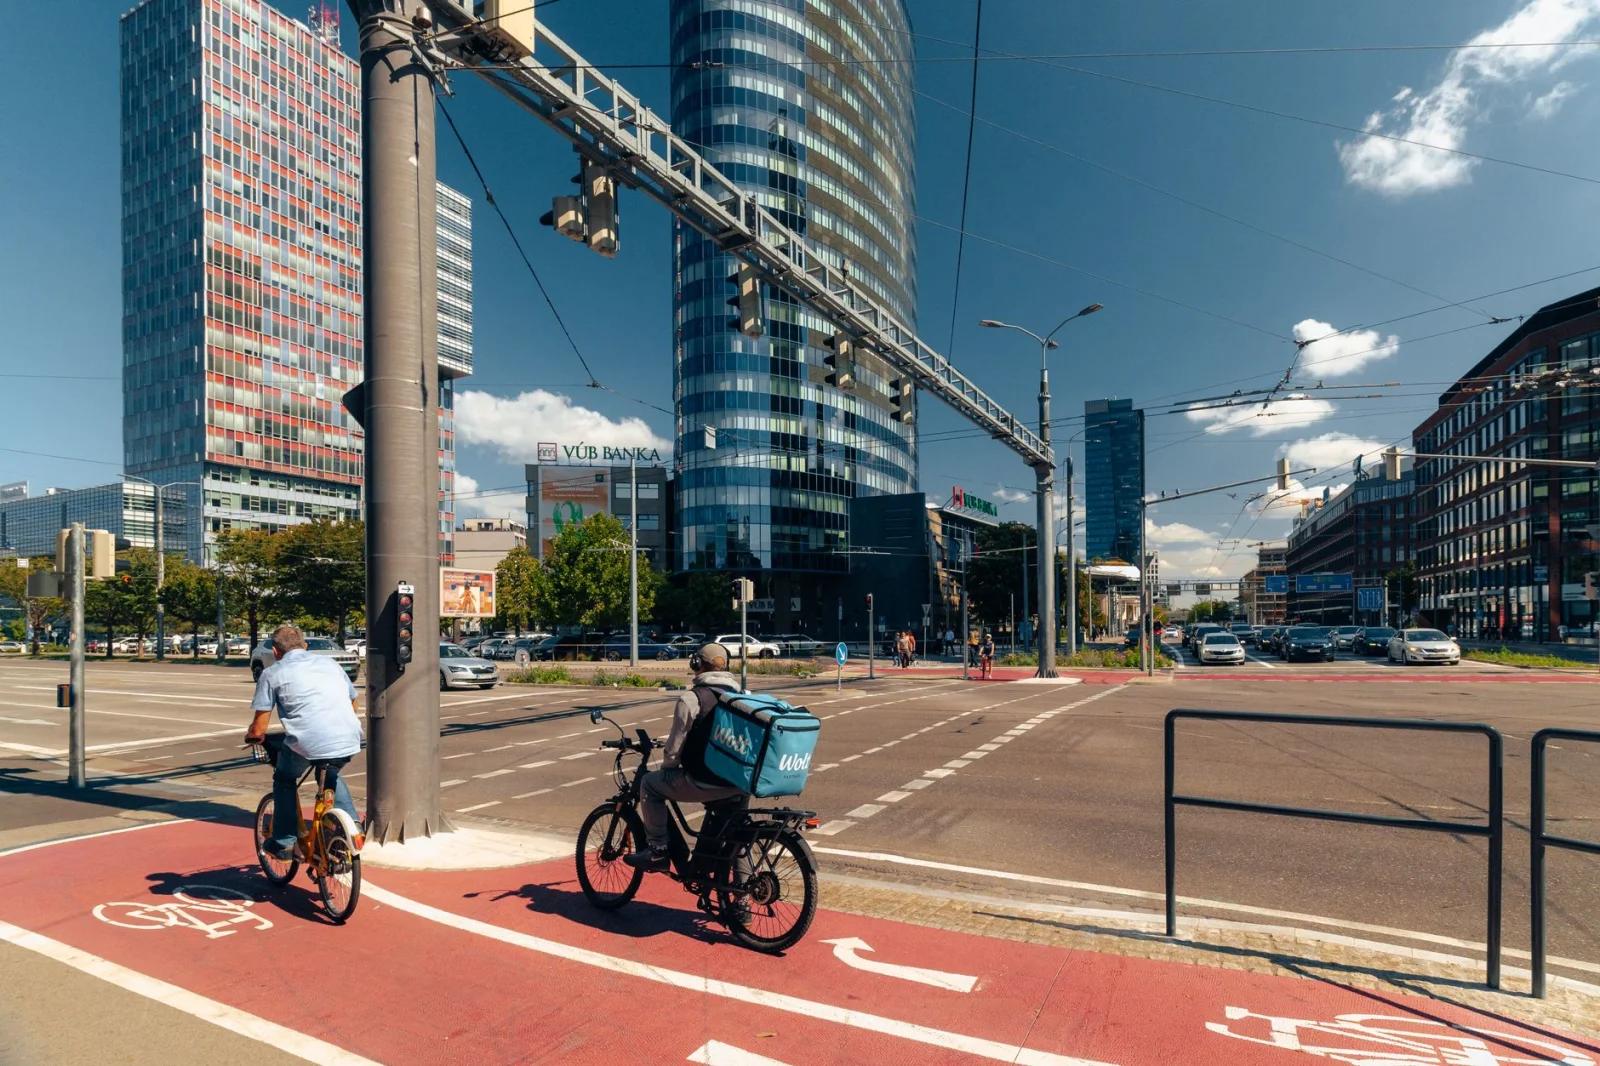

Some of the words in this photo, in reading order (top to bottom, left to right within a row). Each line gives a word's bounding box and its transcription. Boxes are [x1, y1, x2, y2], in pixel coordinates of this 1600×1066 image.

[563, 442, 598, 459] VÚB
[603, 446, 661, 461] BANKA
[714, 724, 749, 755] Wolt
[778, 752, 811, 772] Wolt
